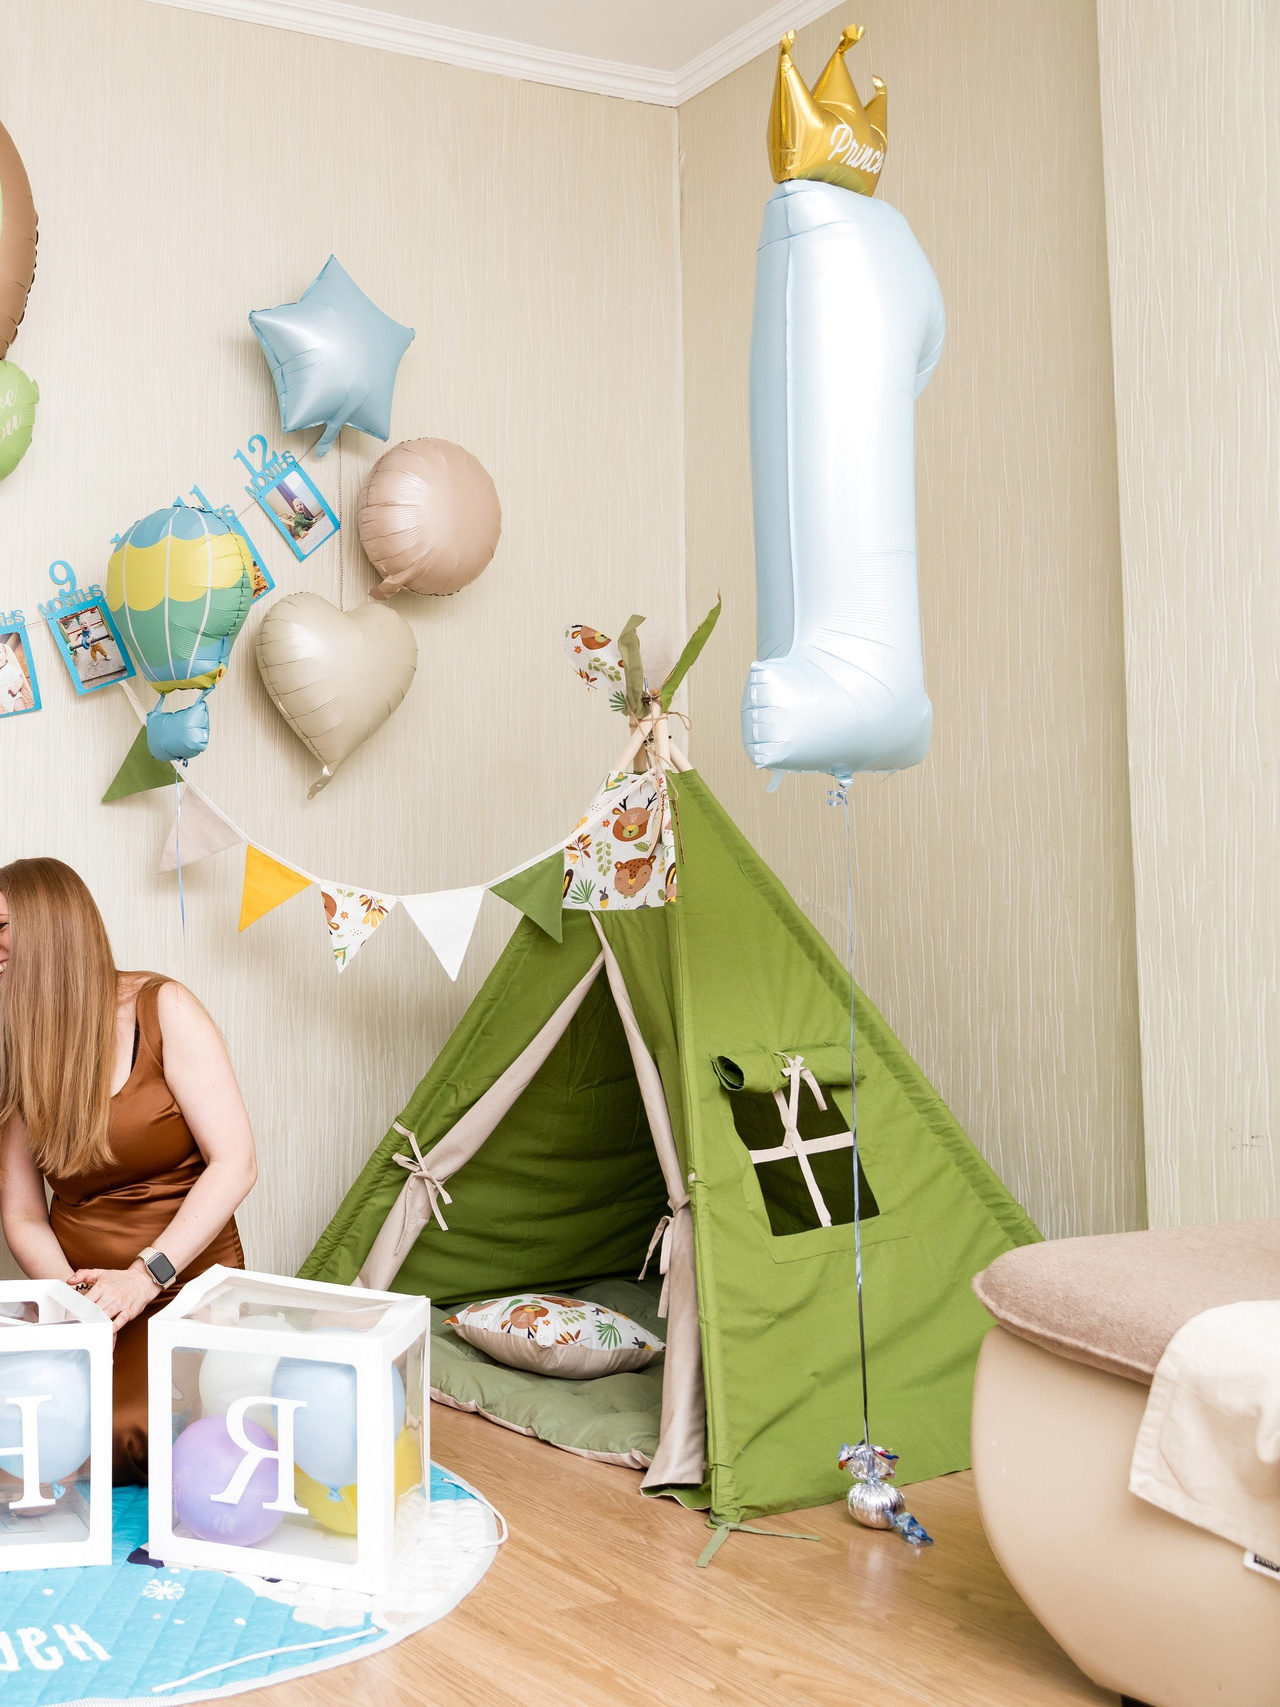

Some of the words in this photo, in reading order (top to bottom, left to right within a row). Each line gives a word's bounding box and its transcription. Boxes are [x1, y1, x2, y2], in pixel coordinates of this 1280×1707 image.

[232, 433, 280, 478] 12
[244, 450, 297, 501] MONTHS
[38, 583, 105, 618] MONTHS
[48, 559, 78, 600] 9
[210, 1395, 309, 1516] Я
